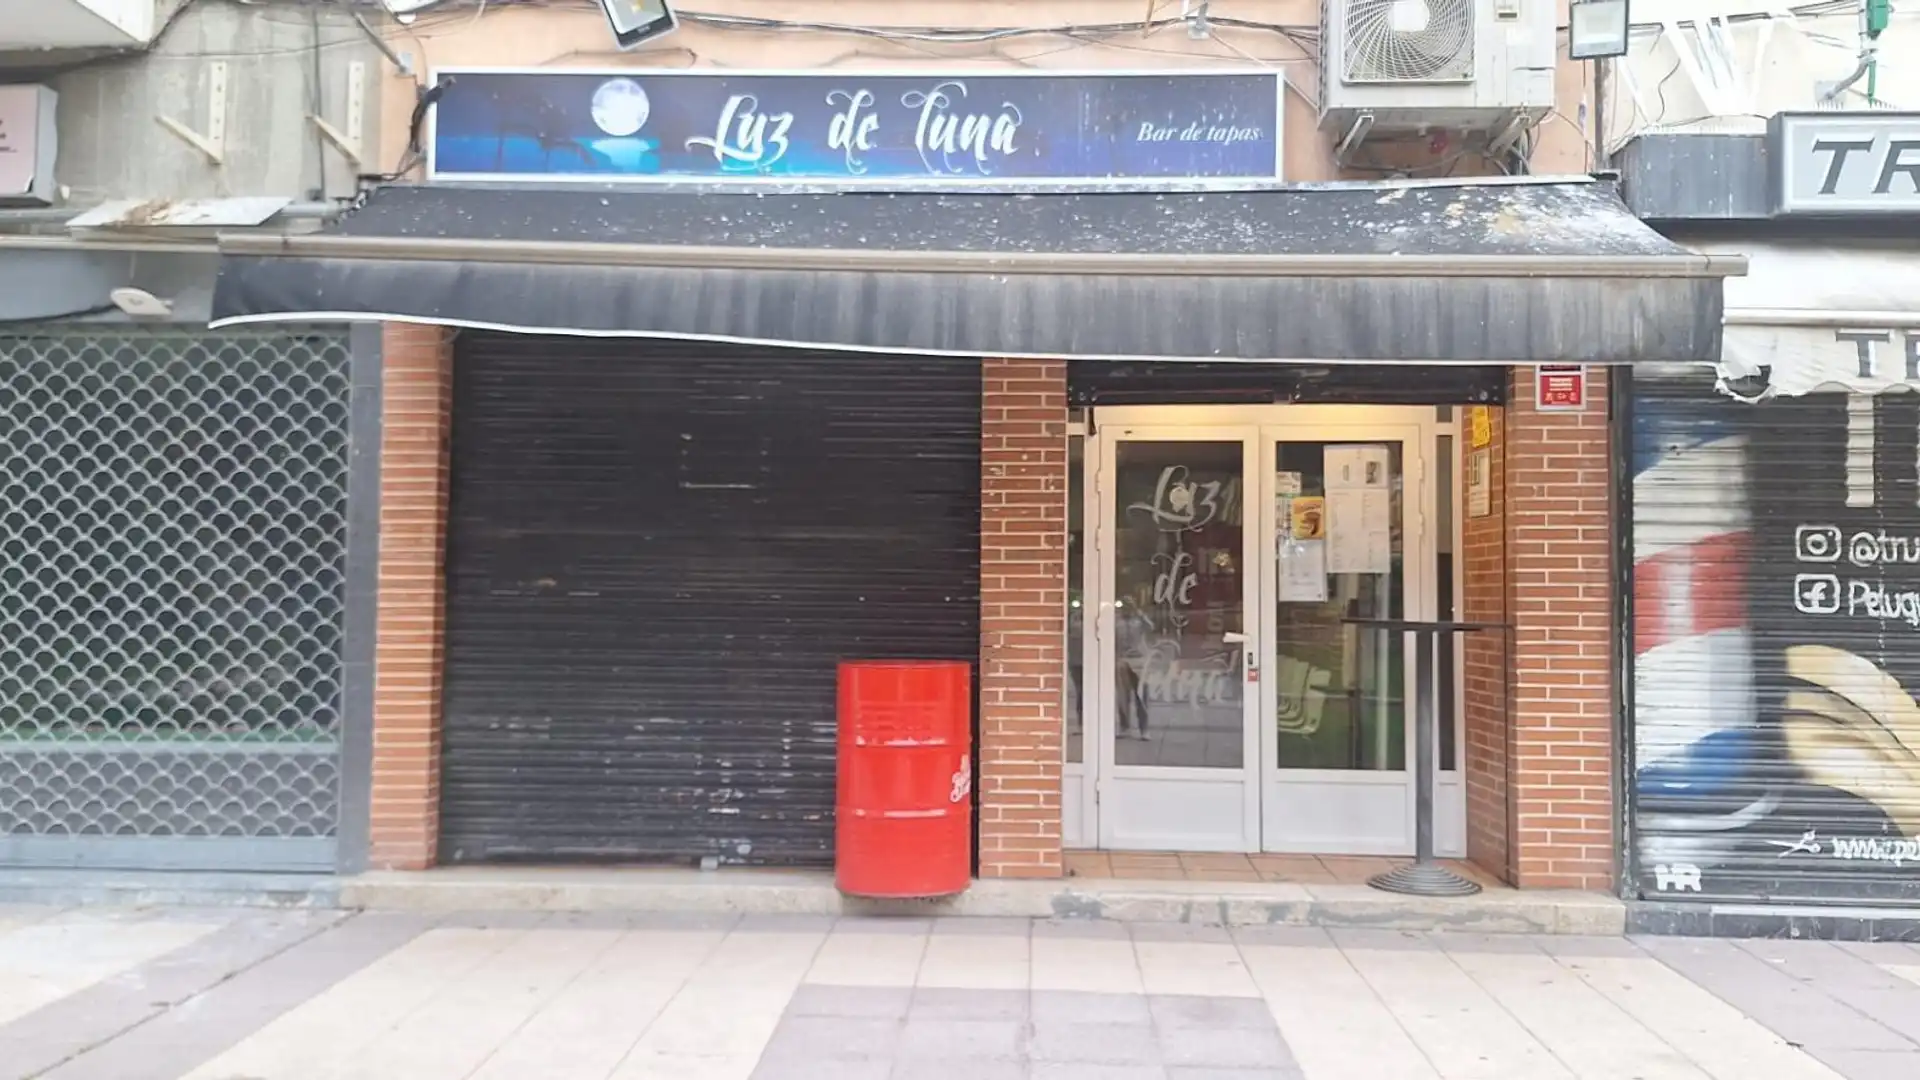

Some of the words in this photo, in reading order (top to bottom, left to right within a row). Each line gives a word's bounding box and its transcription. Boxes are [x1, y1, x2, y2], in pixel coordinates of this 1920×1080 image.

[684, 95, 794, 171] Luz
[826, 89, 880, 174] de
[1136, 121, 1177, 142] Bar
[1180, 120, 1203, 141] de
[1206, 124, 1261, 146] tapas
[1811, 137, 1920, 195] TR
[1126, 465, 1221, 532] Luz
[1151, 553, 1198, 626] de
[1848, 581, 1920, 626] Peluq
